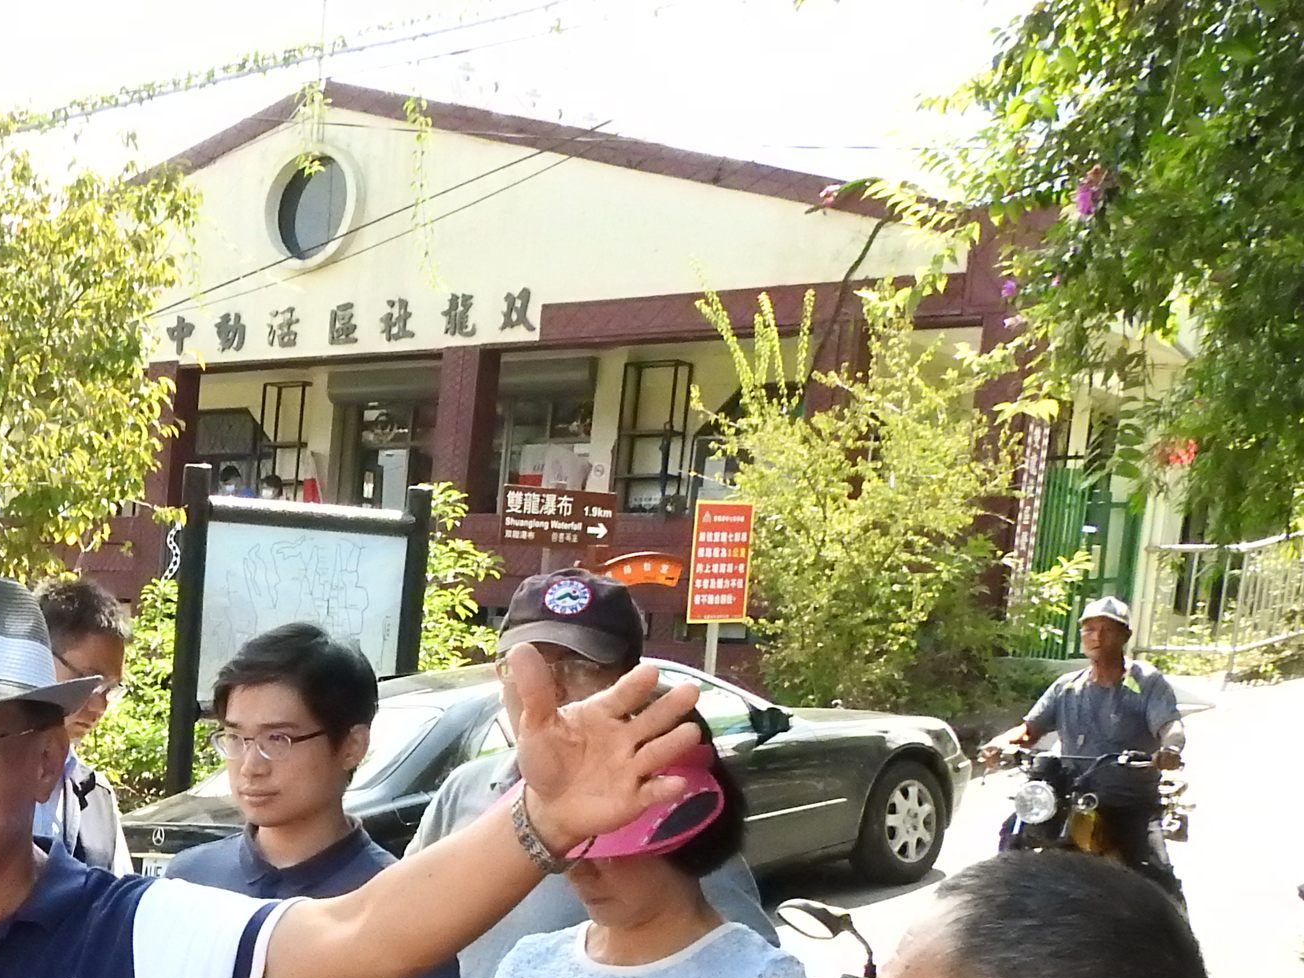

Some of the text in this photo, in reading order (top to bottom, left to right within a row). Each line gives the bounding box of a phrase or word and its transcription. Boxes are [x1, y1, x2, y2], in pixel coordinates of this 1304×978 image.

[505, 490, 574, 517] 雙龍瀑布
[583, 505, 613, 518] 1.9km
[504, 516, 583, 531] Shuanglong Waterfall
